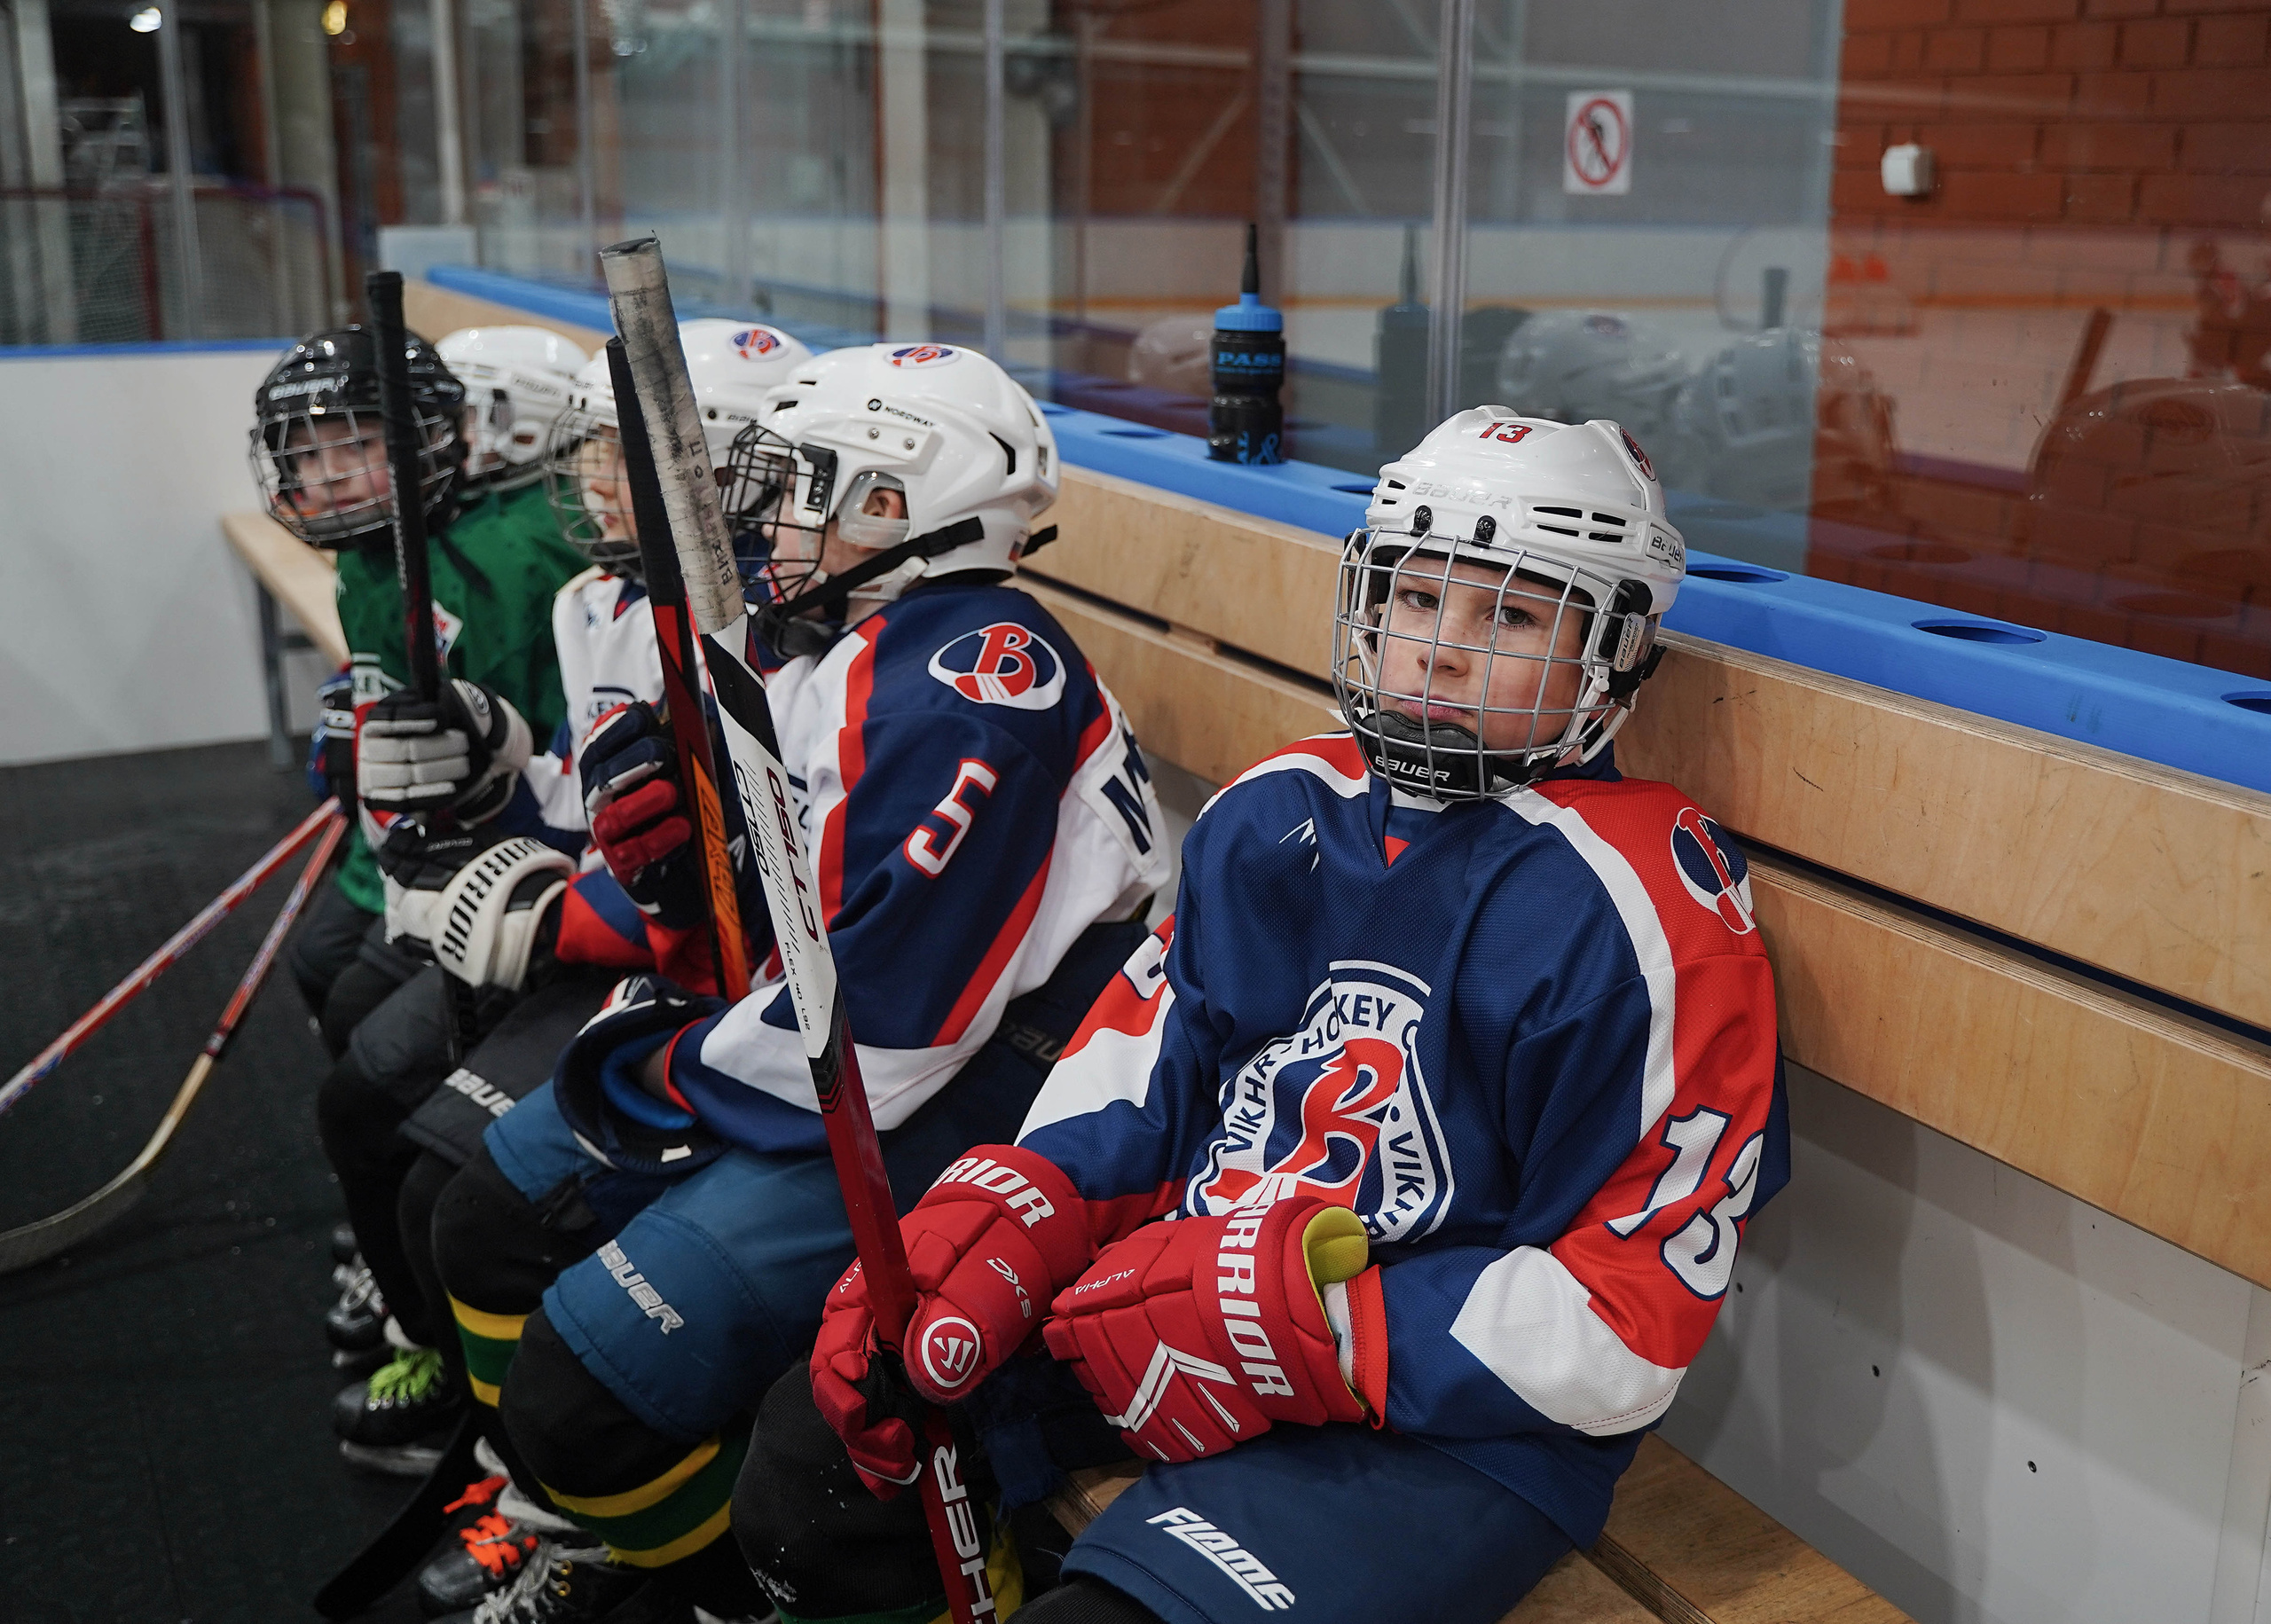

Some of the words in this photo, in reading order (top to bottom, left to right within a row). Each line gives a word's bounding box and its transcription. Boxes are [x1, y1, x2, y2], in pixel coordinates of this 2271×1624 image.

[1479, 422, 1533, 443] 13
[1411, 481, 1513, 509] BAUER
[733, 759, 770, 877] CT150
[903, 758, 1000, 879] 5
[1375, 755, 1450, 781] BAUER
[766, 765, 820, 943] CT150
[783, 942, 798, 977] FLEX
[795, 982, 804, 1000] 40
[800, 1008, 812, 1032] L92
[1222, 1053, 1276, 1154] VIKHR
[1301, 992, 1397, 1055] HOKEY
[1604, 1104, 1766, 1301] 13
[1074, 1268, 1136, 1295] ALPHA
[933, 1442, 999, 1624] HER
